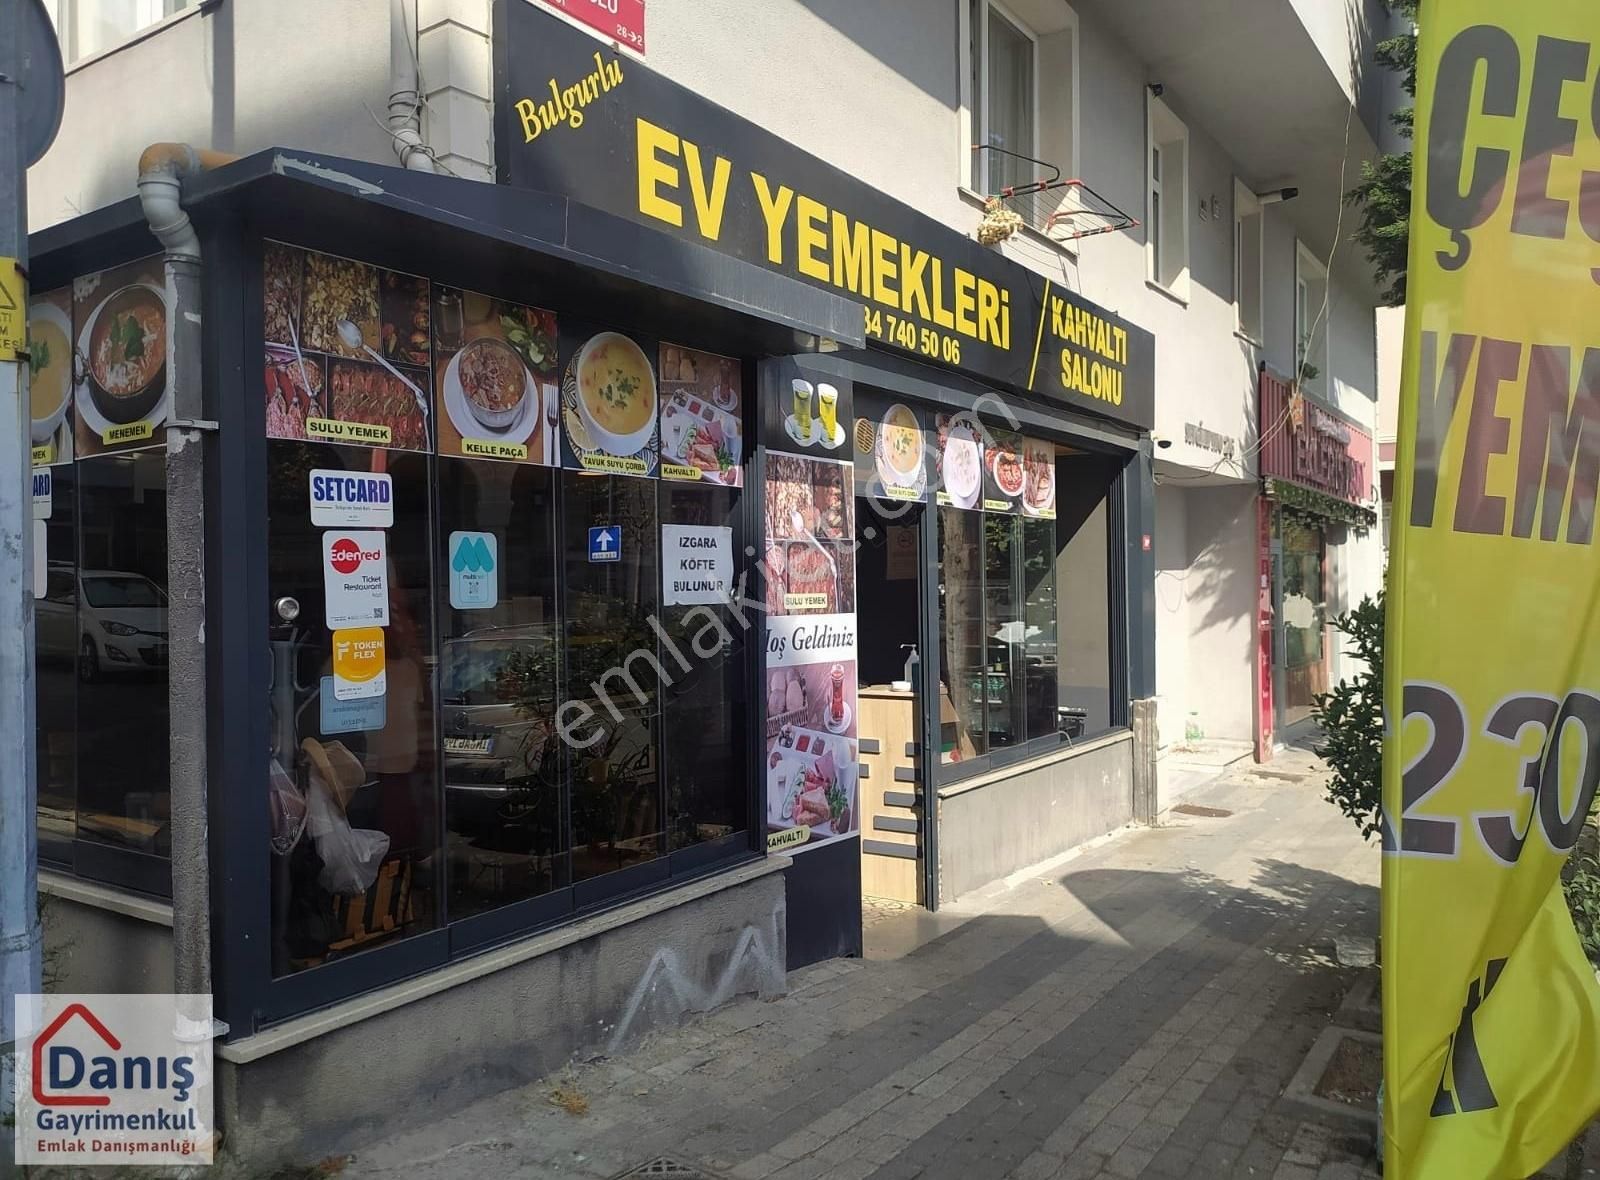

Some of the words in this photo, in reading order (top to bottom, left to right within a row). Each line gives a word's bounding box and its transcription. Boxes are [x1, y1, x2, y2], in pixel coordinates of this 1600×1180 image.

[514, 52, 624, 144] Bulgurlu
[636, 117, 732, 241] EV
[1051, 295, 1128, 366] KAHVALTI
[886, 315, 917, 350] 740
[921, 328, 939, 358] 50
[943, 336, 961, 365] 06
[1060, 347, 1123, 407] SALONU
[108, 423, 147, 440] MENEMEN
[309, 421, 343, 436] SULU
[346, 425, 388, 440] YEMEK
[466, 443, 497, 456] KELLE
[499, 446, 524, 458] PAÇA
[583, 457, 605, 467] TAVUK
[606, 459, 624, 469] SUYU
[625, 461, 646, 472] ÇORBA
[663, 467, 696, 477] KAHVALTI
[313, 475, 390, 504] SETCARD
[679, 536, 718, 549] IZGARA
[330, 549, 381, 562] Edenred
[673, 580, 724, 593] BULUNUR
[785, 596, 804, 606] SULU
[804, 595, 826, 606] YEMEK
[353, 641, 383, 650] TOKEN
[791, 624, 854, 652] Geldiniz
[353, 650, 376, 660] FLEX
